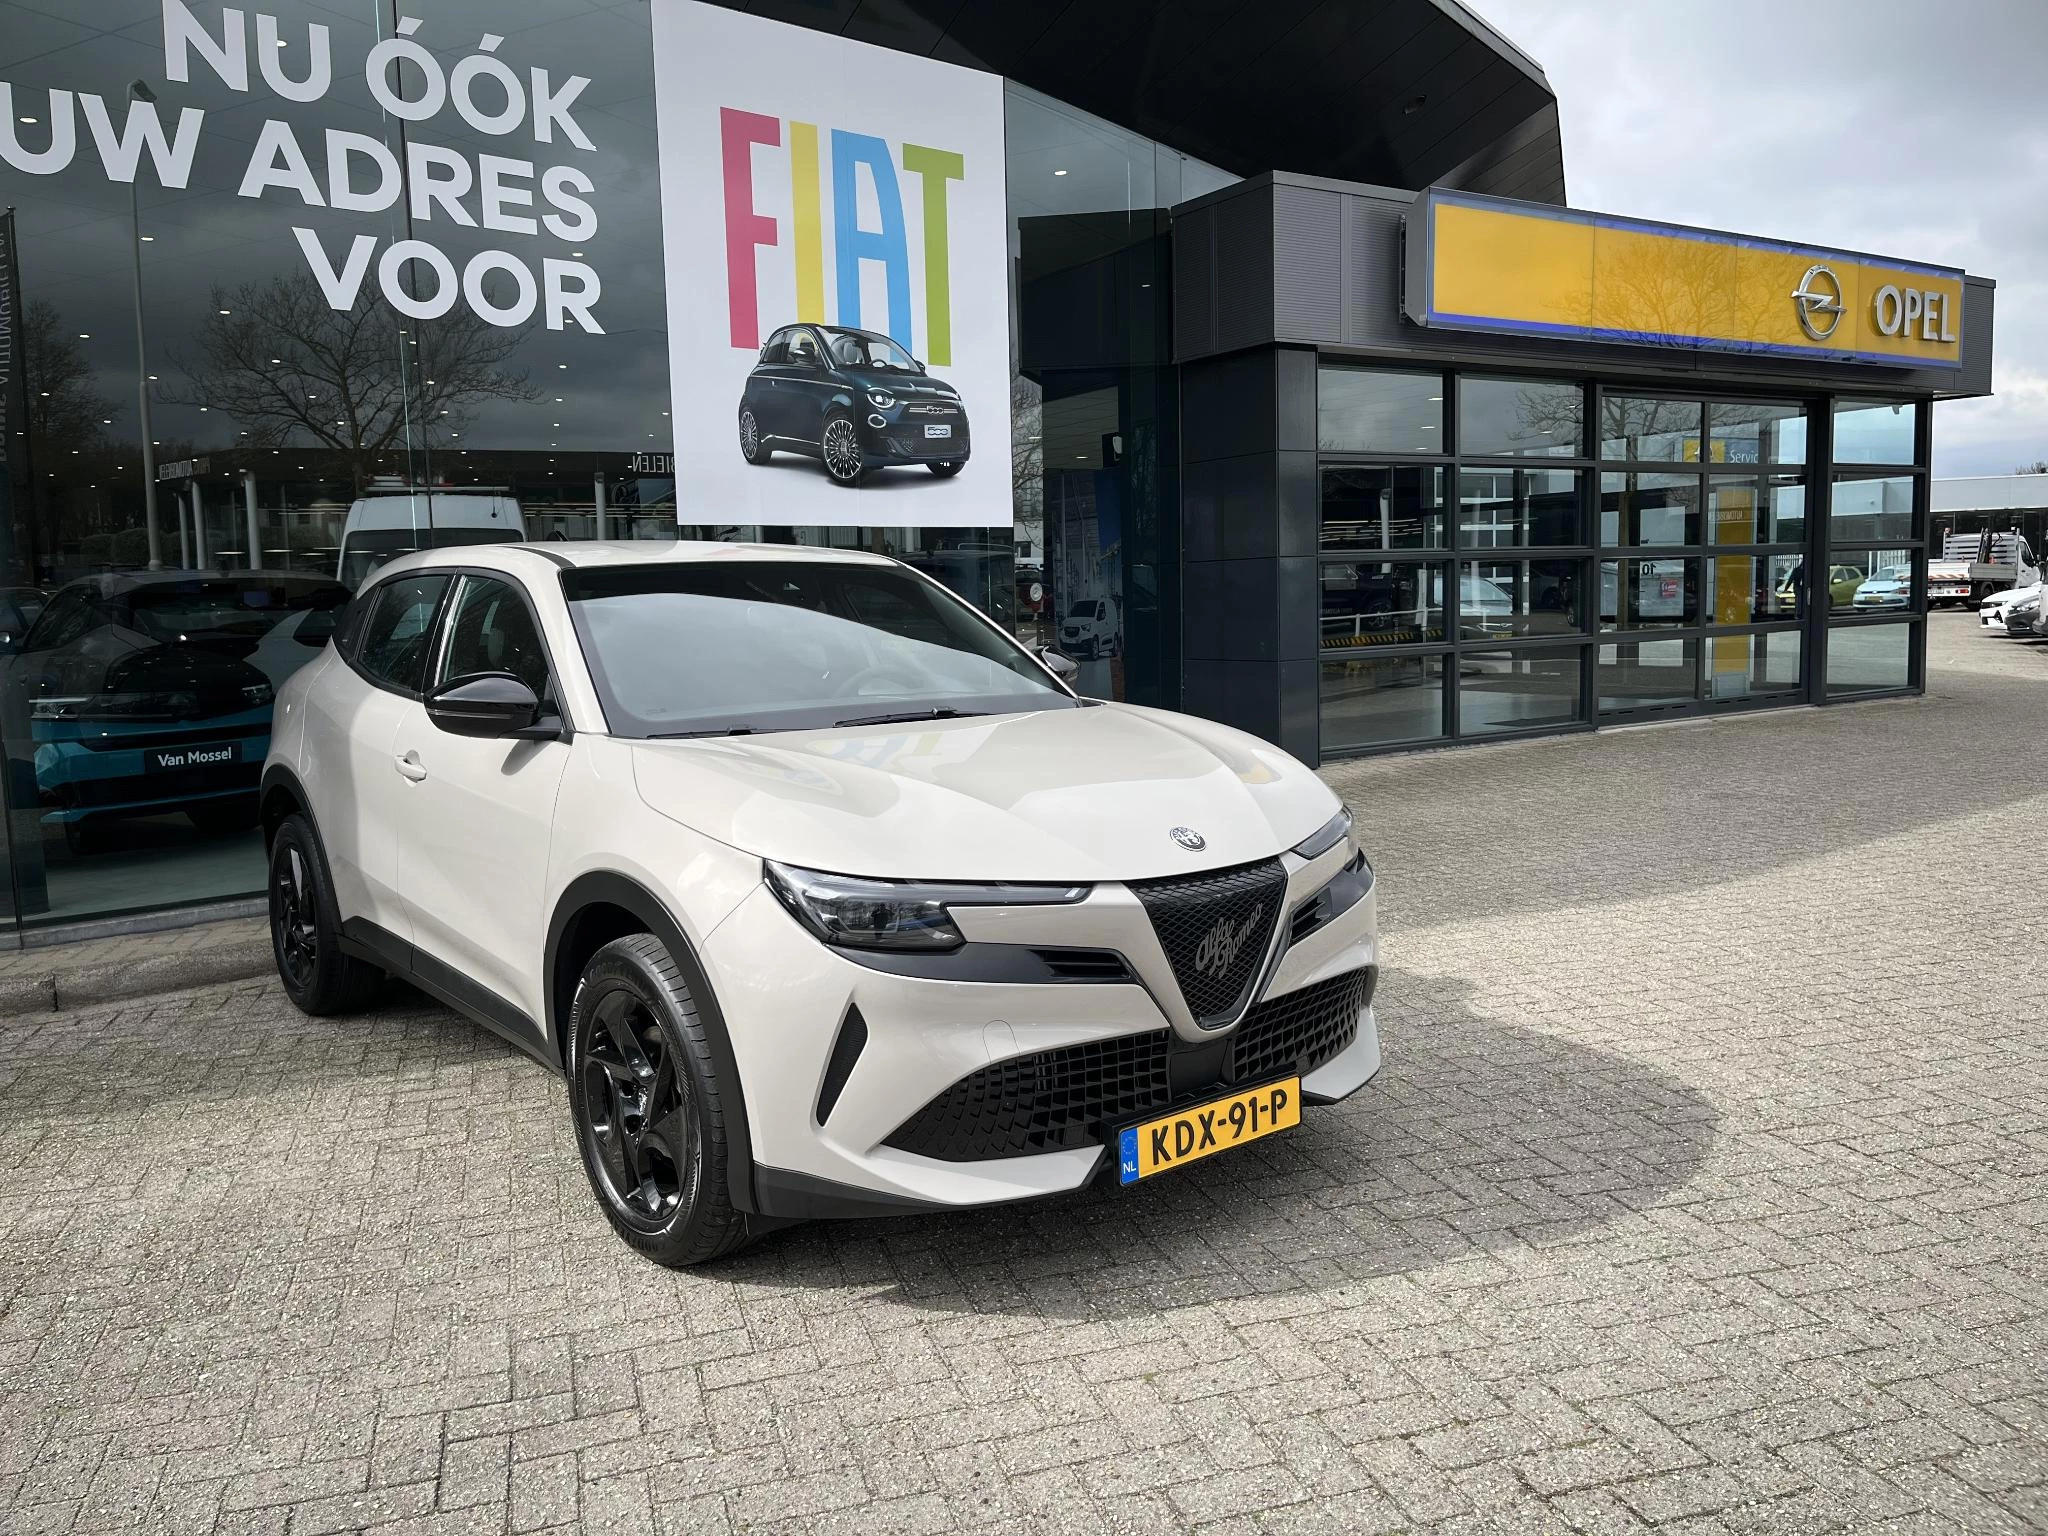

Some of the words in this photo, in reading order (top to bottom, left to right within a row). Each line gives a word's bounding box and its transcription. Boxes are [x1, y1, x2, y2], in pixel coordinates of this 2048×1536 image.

[162, 0, 331, 102] NU
[365, 16, 596, 151] ÓÓK
[0, 82, 205, 189] UW
[238, 119, 598, 242] ADRES
[292, 226, 606, 335] VOOR
[720, 106, 964, 366] FIAT
[1875, 284, 1955, 342] OPEL
[157, 753, 184, 767] Van
[187, 746, 231, 764] Mossel
[1123, 1160, 1137, 1174] NL
[1152, 1089, 1288, 1166] KDX-91-P
